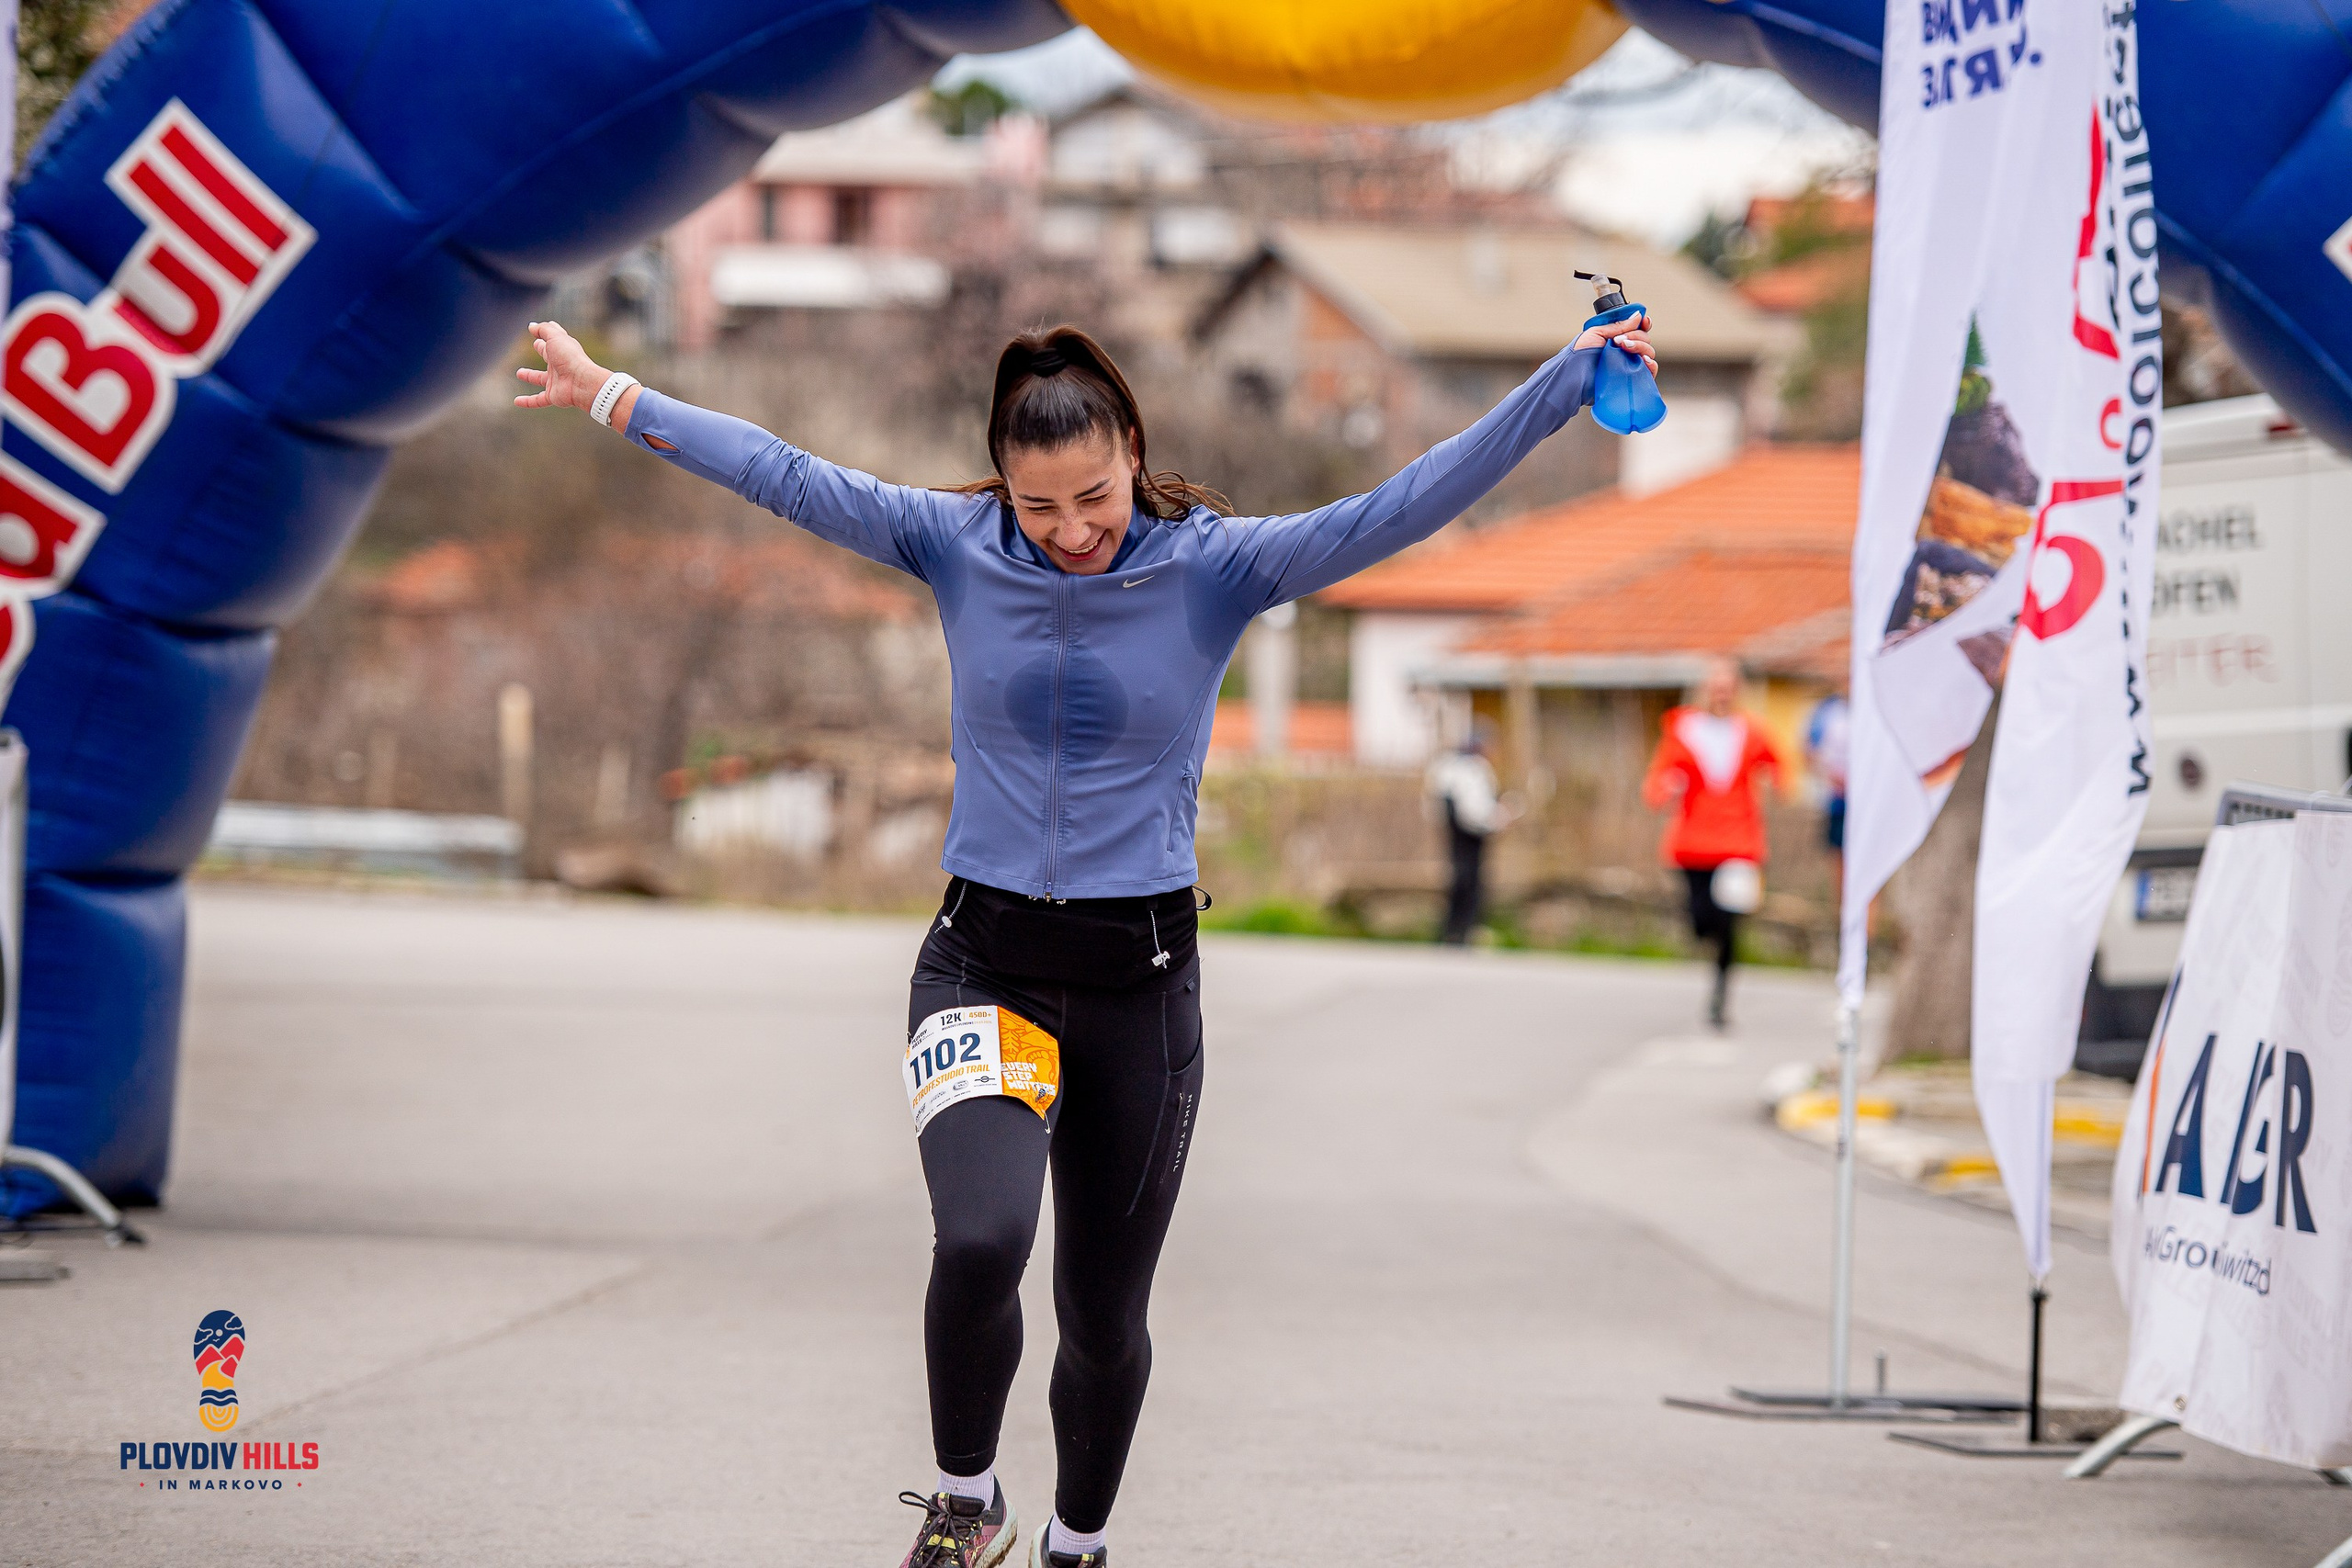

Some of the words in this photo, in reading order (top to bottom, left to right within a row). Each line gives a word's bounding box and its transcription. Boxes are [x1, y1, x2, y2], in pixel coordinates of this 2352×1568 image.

[0, 106, 311, 487] Bull
[940, 1011, 962, 1026] 12K
[910, 1032, 982, 1090] 1102
[966, 1064, 990, 1074] TRAIL
[1001, 1062, 1037, 1073] EVERY
[1002, 1071, 1034, 1081] STEP
[1182, 1093, 1193, 1128] NIKE
[1172, 1132, 1186, 1172] TRAIL
